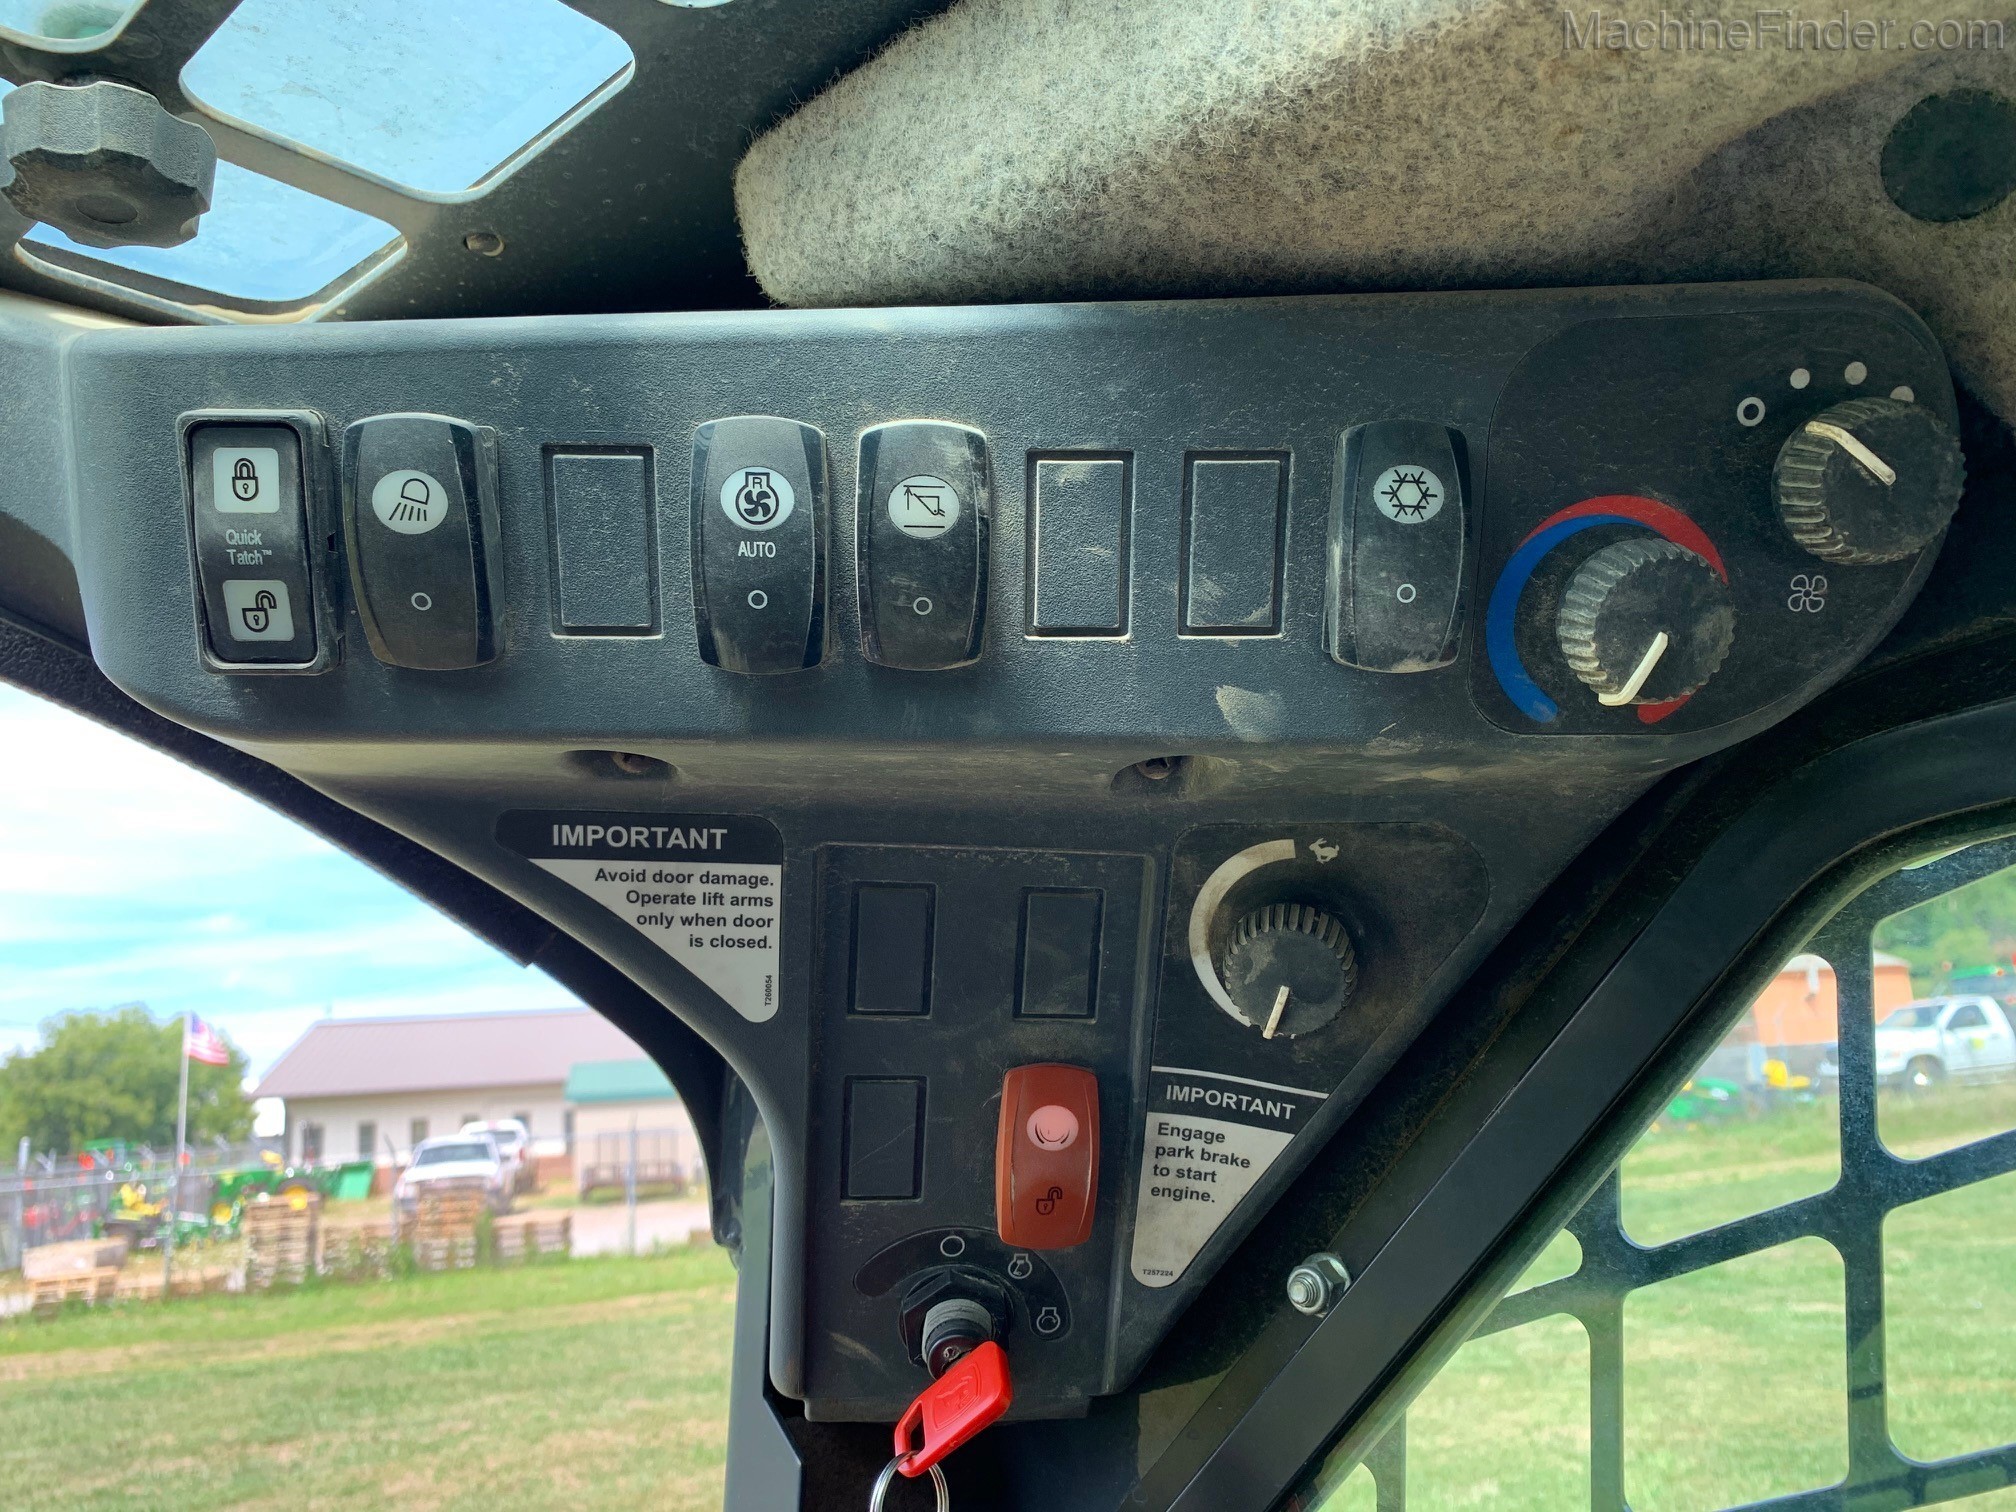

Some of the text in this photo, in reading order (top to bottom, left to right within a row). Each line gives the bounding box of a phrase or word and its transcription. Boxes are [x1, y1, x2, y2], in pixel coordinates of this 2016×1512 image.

[225, 529, 263, 546] Quick
[738, 541, 777, 558] AUTO
[552, 824, 728, 850] IMPORTANT
[594, 868, 775, 888] Avoid door damage.
[626, 890, 774, 908] Operate lift arms
[636, 912, 774, 929] only when door
[689, 934, 773, 949] is closed.
[764, 974, 773, 1007] T260054
[1166, 1084, 1296, 1120] IMPORTANT
[1157, 1122, 1226, 1144] Engage
[1154, 1144, 1251, 1169] park brake
[1153, 1163, 1217, 1183] to start
[1150, 1185, 1216, 1203] engine.
